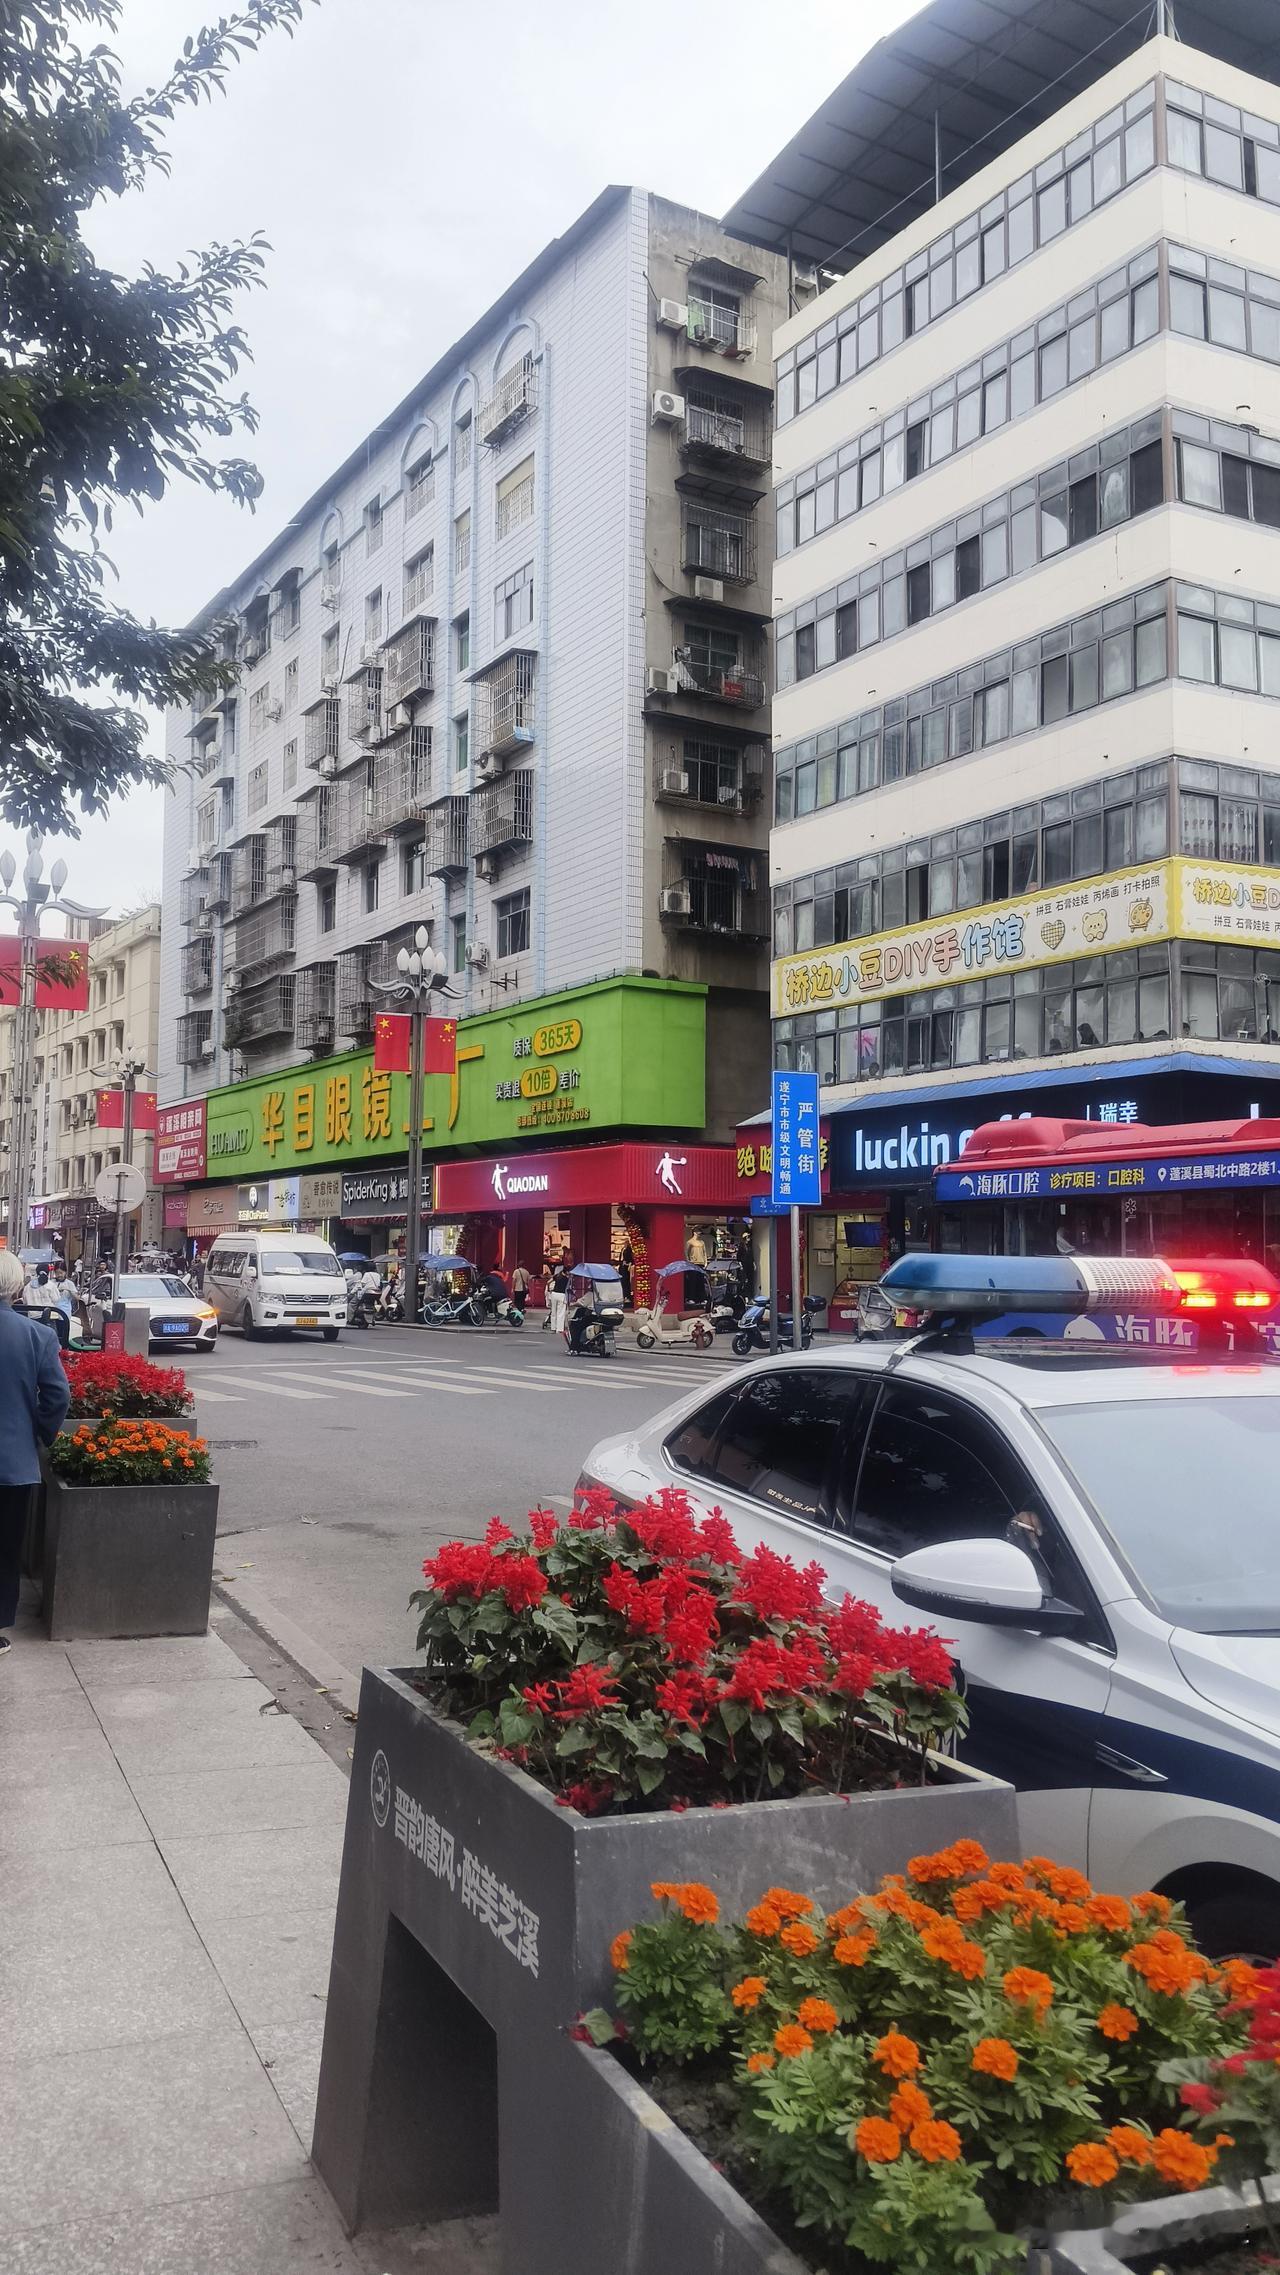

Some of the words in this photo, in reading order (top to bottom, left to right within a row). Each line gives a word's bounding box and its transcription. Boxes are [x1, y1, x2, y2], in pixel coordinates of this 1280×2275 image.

[1036, 903, 1052, 916] 拼豆
[1056, 894, 1089, 912] 石膏娃娃
[1093, 886, 1119, 902] 丙烯画
[1124, 875, 1160, 895] 打卡拍照
[1214, 915, 1231, 928] 拼豆
[1236, 917, 1271, 932] 石膏娃娃
[786, 914, 1024, 1005] 桥边小豆DIY手作馆
[514, 1037, 531, 1057] 质保
[541, 1025, 574, 1051] 365天
[496, 1080, 520, 1099] 买贵退
[527, 1069, 551, 1093] 10倍
[560, 1069, 580, 1090] 差价
[1099, 1101, 1138, 1123] 瑞幸
[779, 1081, 791, 1195] 遂宁市市级文明畅通
[798, 1102, 815, 1174] 严管街
[855, 1122, 949, 1171] luckin
[343, 1179, 388, 1205] SpiderKing
[399, 1176, 431, 1197] 蜘王
[507, 1175, 548, 1193] QIAODAN
[976, 1171, 1040, 1196] 海豚口腔
[1108, 1167, 1145, 1187] 口腔科
